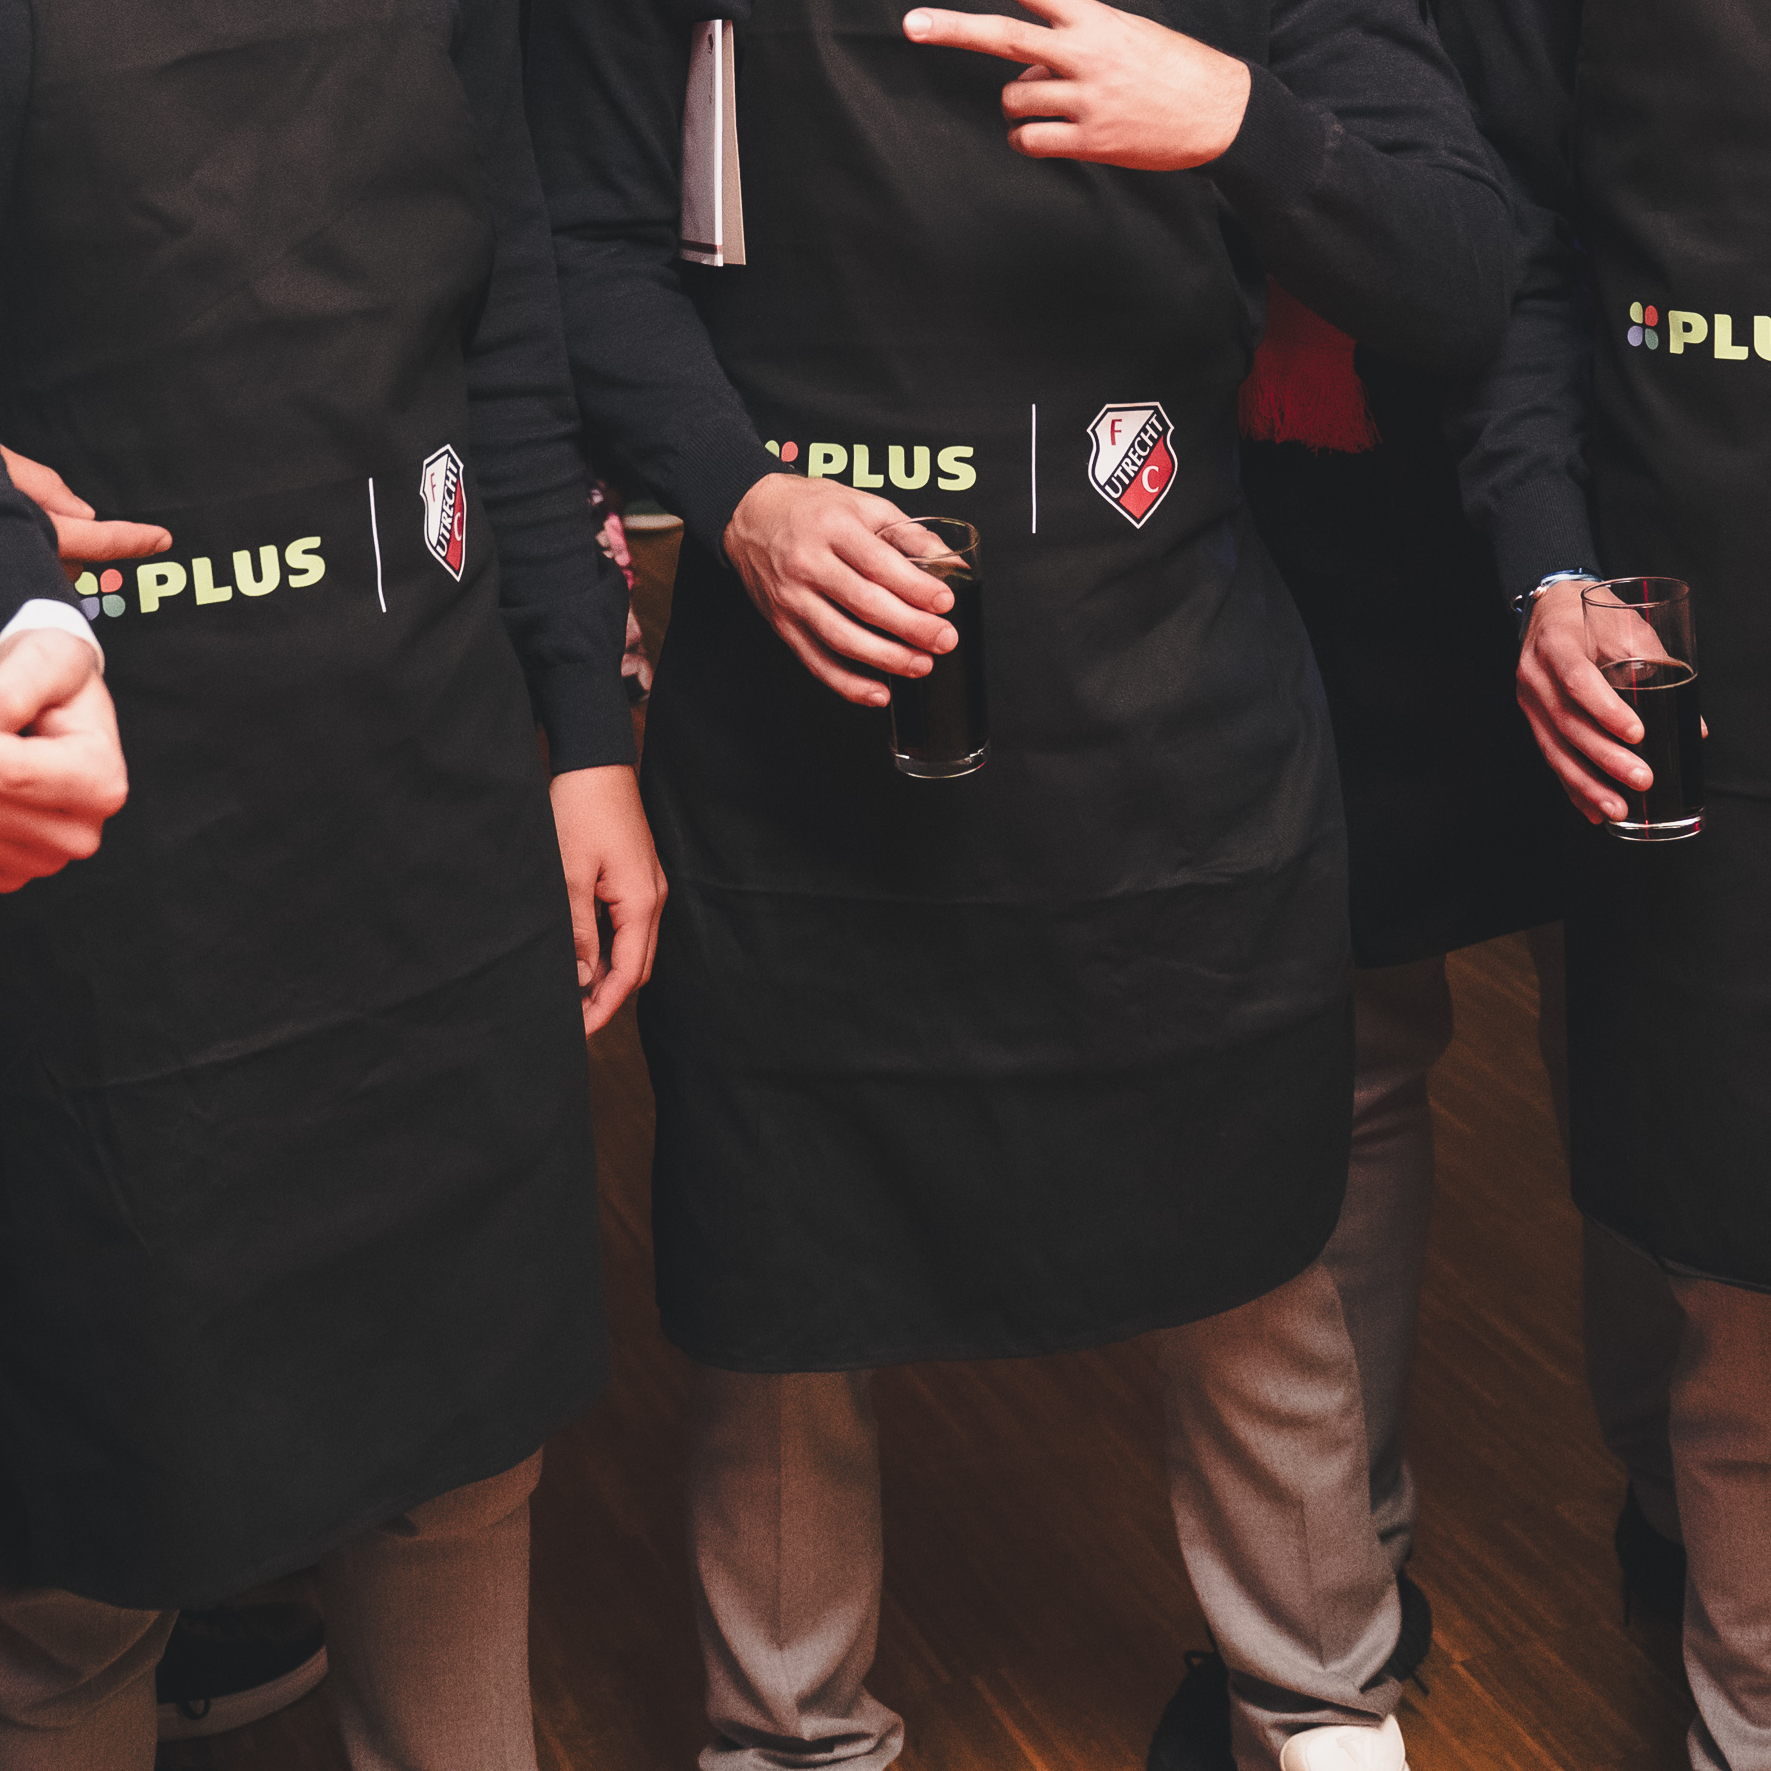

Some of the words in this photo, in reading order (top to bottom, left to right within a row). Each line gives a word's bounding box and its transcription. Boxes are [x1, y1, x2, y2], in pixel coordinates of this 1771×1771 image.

[1110, 418, 1123, 446] F
[808, 442, 977, 491] PLUS
[1104, 414, 1163, 499] UTRECHT
[430, 472, 437, 503] F
[1142, 465, 1160, 493] C
[435, 456, 458, 557] UTRECHT
[453, 512, 462, 541] C
[136, 536, 326, 613] PLUS
